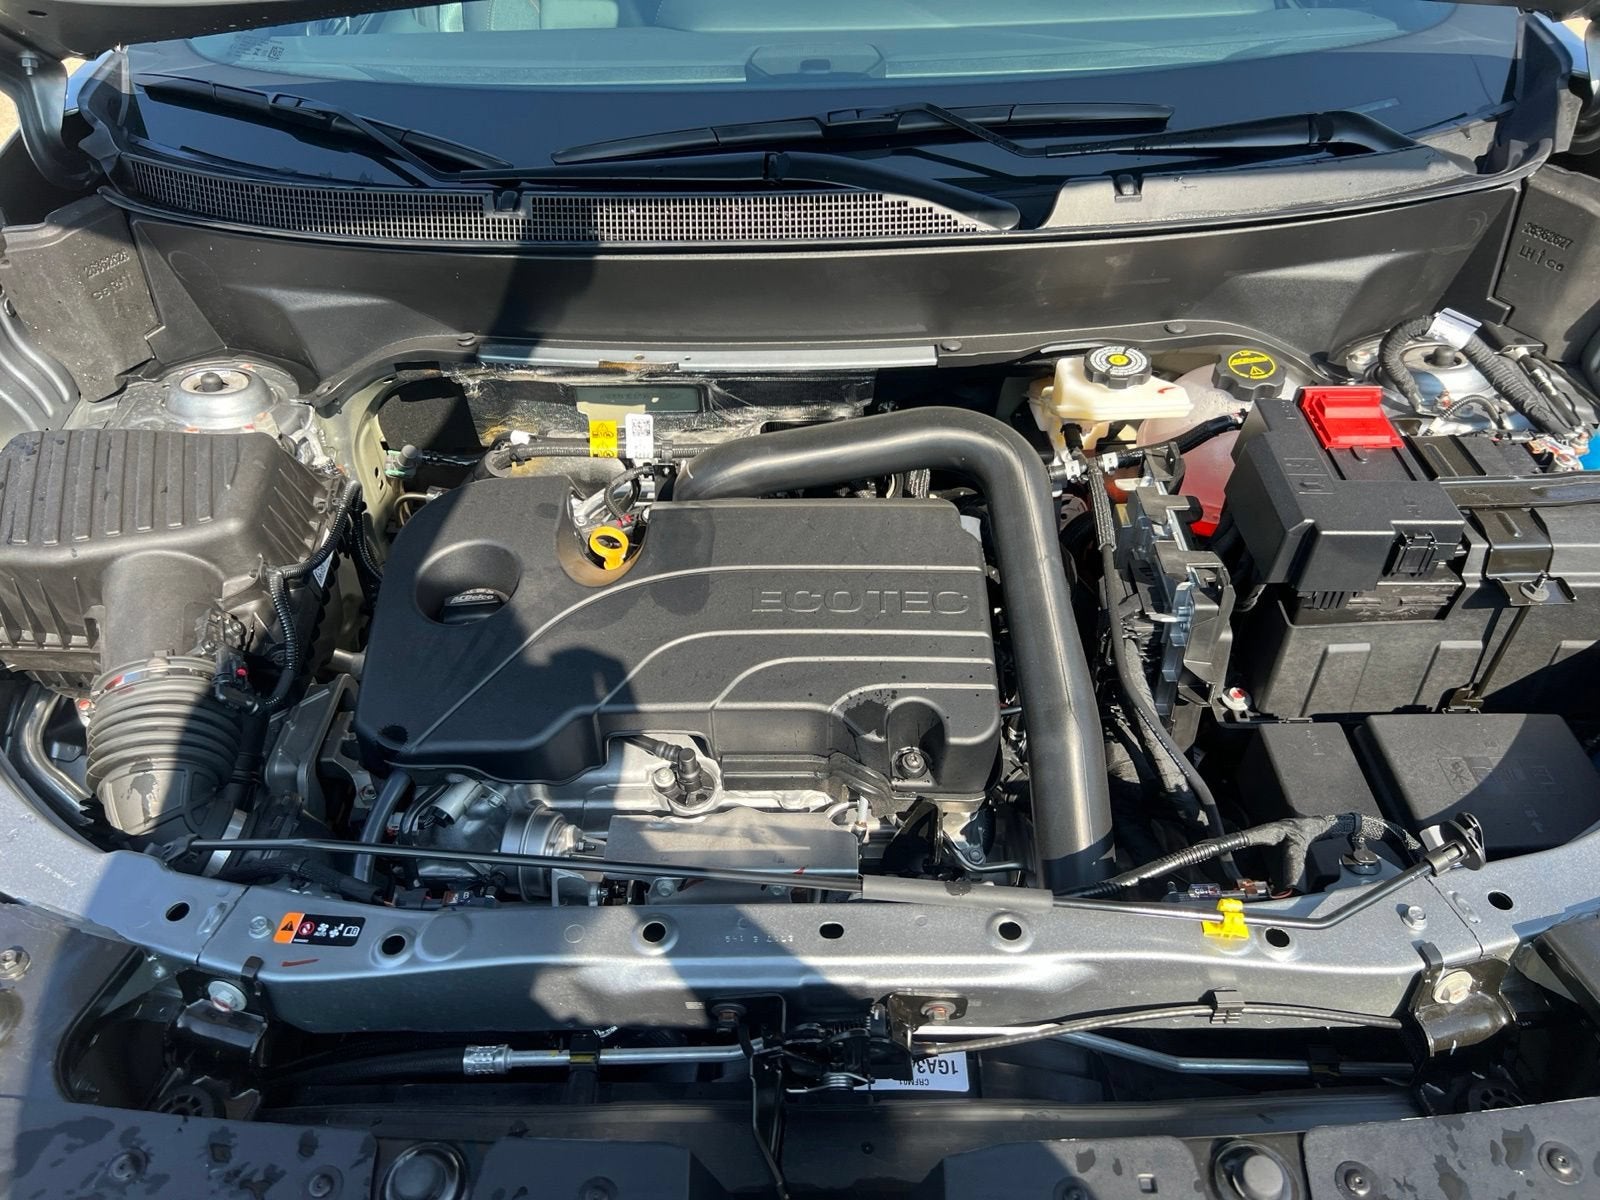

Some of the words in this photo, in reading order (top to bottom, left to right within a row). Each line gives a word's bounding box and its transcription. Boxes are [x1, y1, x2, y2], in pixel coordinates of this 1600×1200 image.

[1518, 245, 1536, 261] LH
[751, 590, 970, 614] ECOTEC
[912, 1058, 959, 1075] 1GA3
